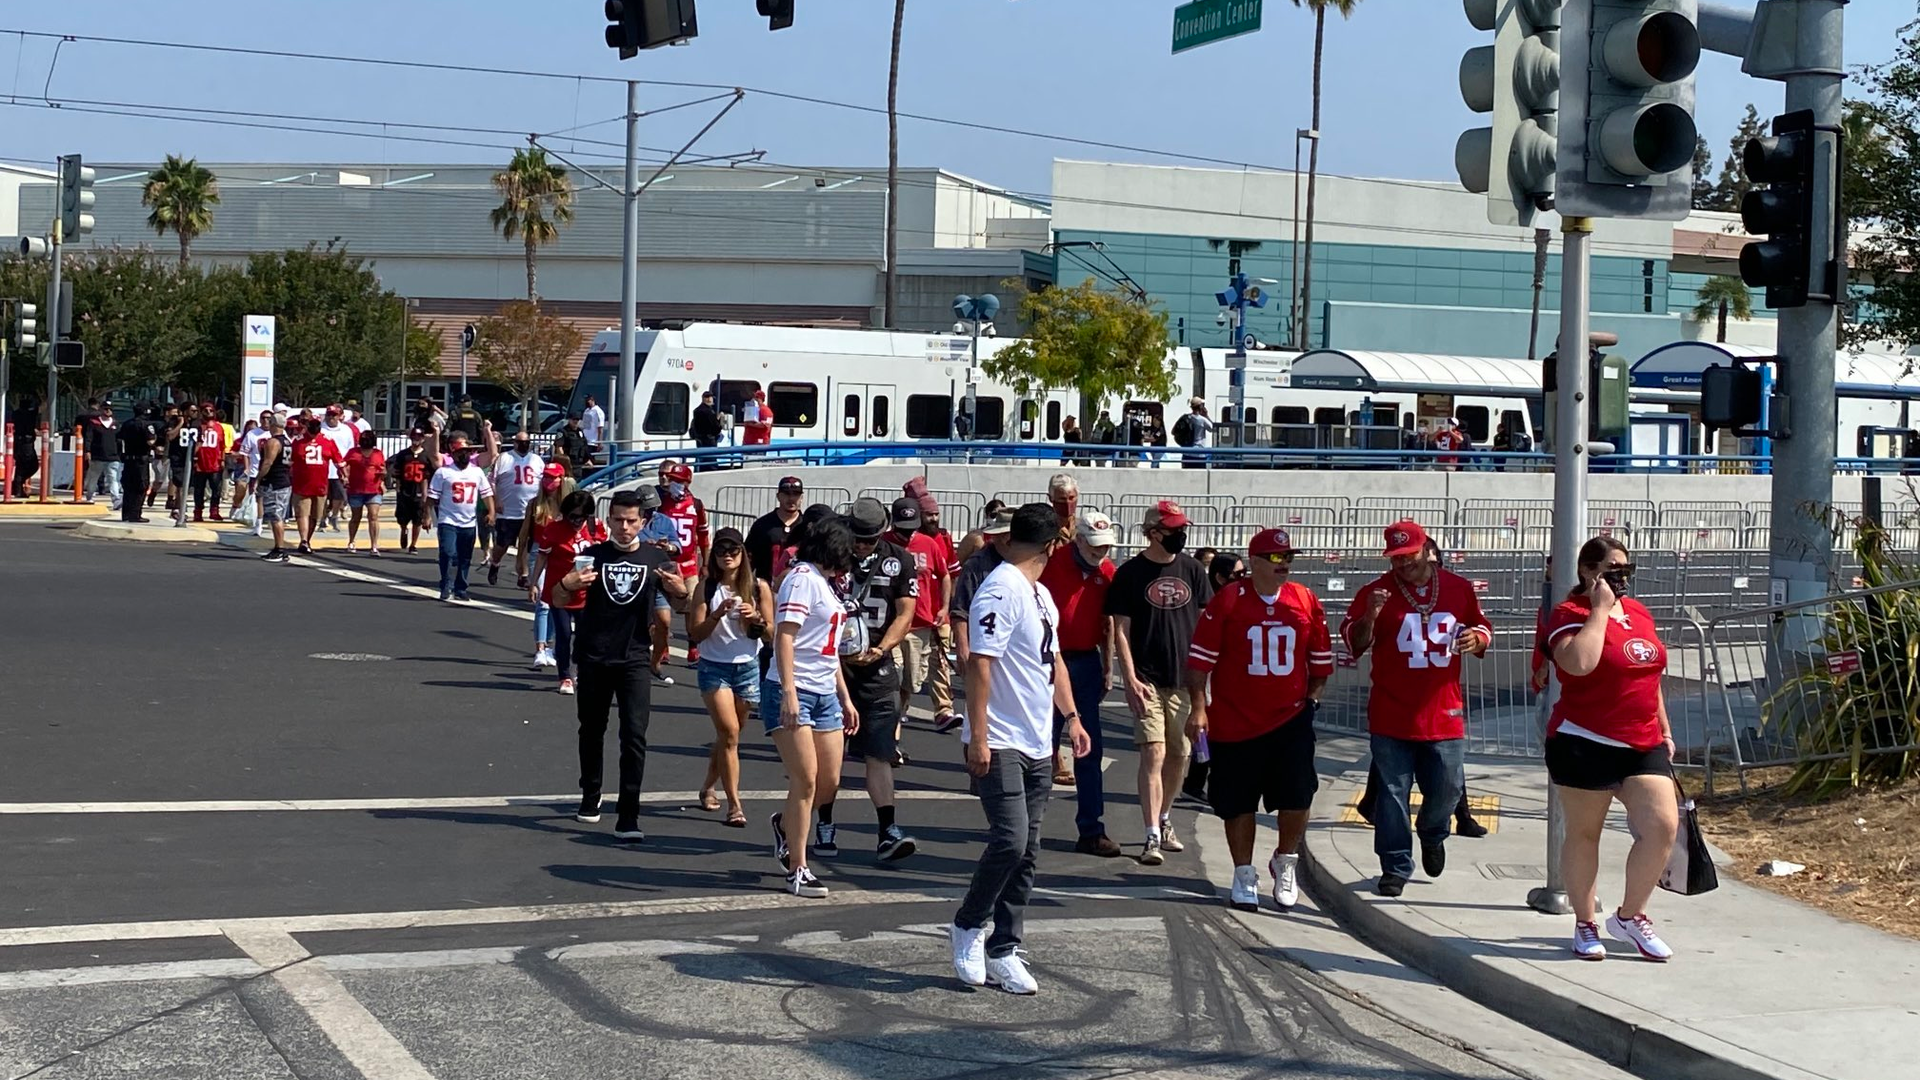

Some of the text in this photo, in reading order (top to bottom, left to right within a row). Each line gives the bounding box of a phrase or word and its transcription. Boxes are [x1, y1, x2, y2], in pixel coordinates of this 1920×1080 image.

[1174, 0, 1259, 41] Convention Center
[667, 358, 685, 369] 970A
[305, 445, 324, 465] 21
[513, 465, 534, 485] 16
[669, 517, 693, 547] 5
[607, 565, 642, 573] RAIDERS
[979, 612, 996, 635] 4
[1247, 625, 1297, 676] 10
[1397, 612, 1457, 669] 49
